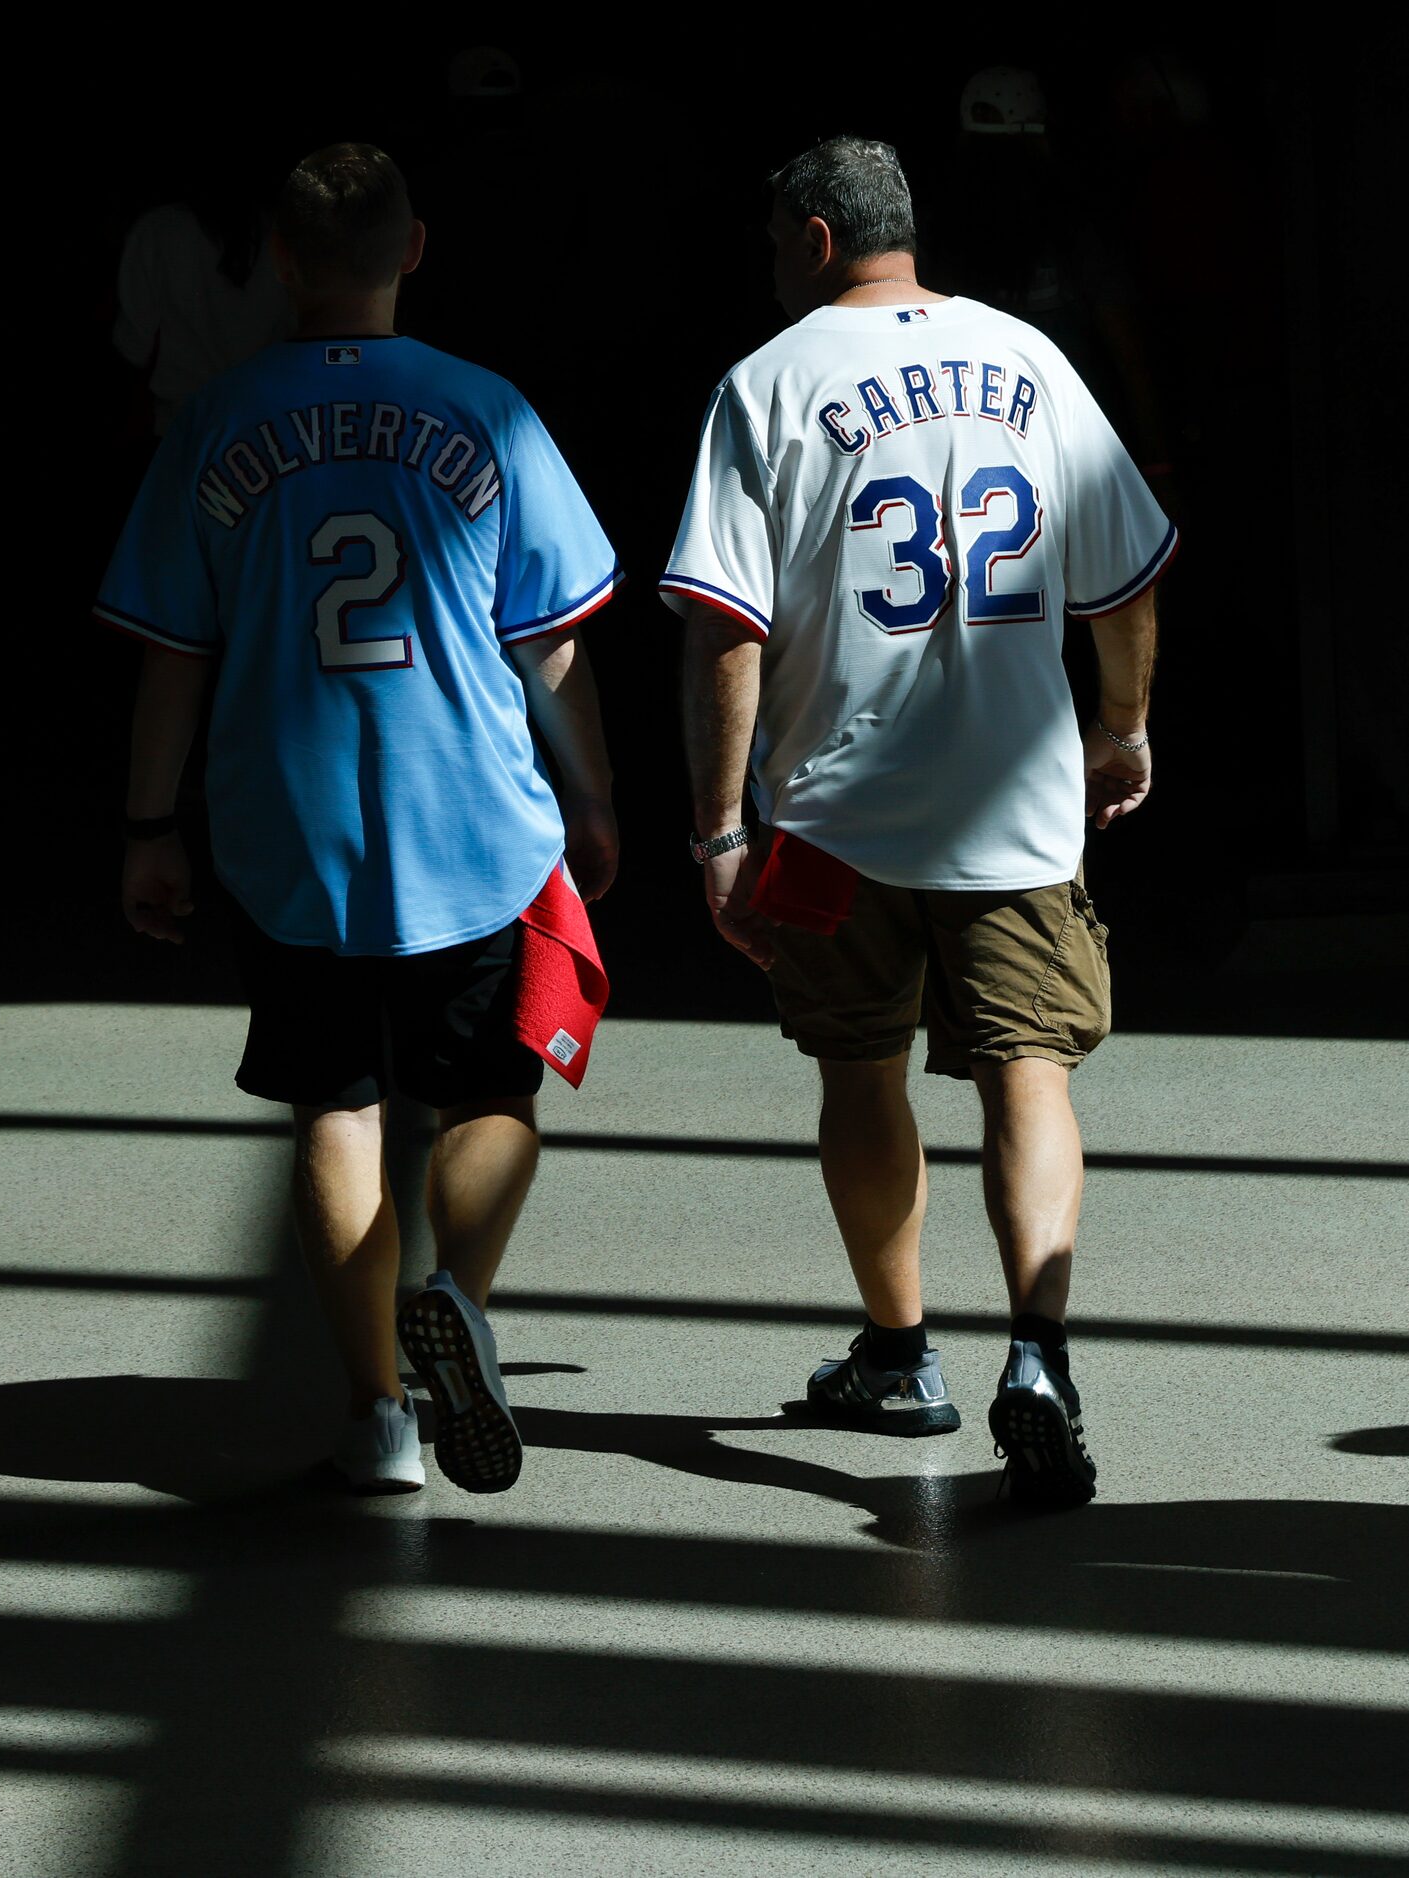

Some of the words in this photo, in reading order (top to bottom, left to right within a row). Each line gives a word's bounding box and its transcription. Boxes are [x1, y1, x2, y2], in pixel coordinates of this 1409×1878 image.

[197, 401, 501, 529] WOLVERTON
[816, 359, 1038, 456] CARTER
[309, 511, 413, 672] 2
[846, 465, 1045, 636] 32
